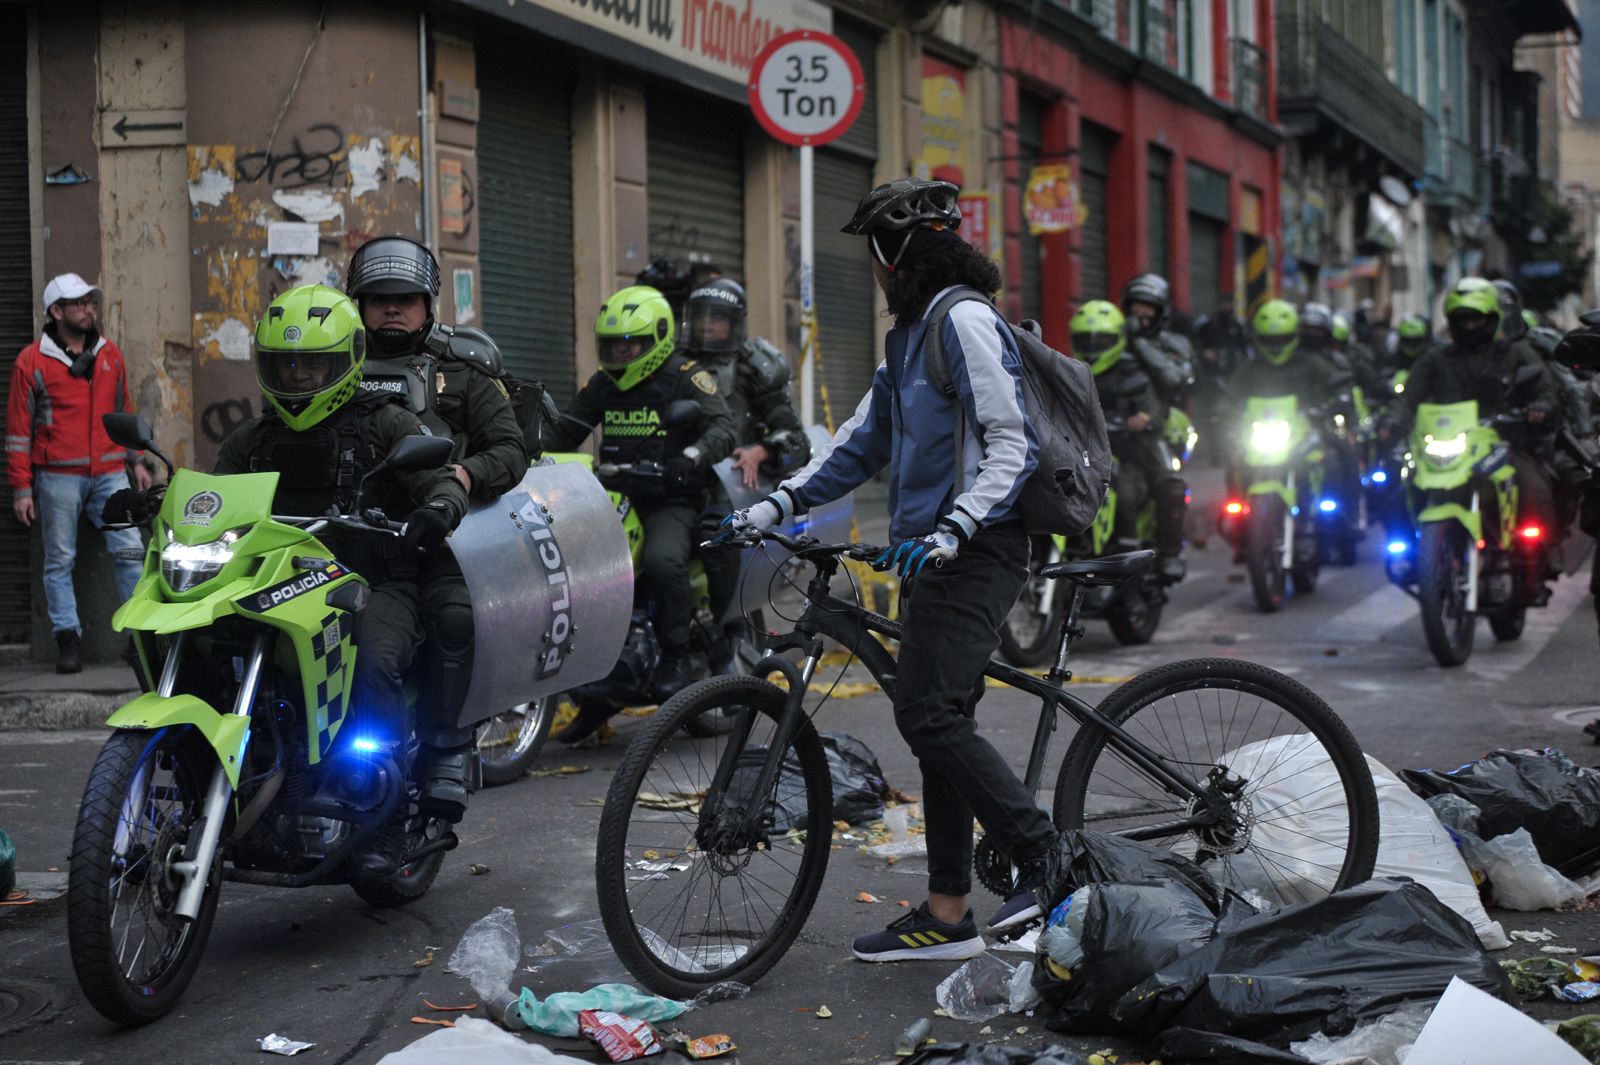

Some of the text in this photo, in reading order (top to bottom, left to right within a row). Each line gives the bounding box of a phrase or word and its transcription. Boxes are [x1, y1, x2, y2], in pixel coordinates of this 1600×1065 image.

[785, 54, 829, 84] 3.5
[776, 87, 837, 117] Ton
[604, 405, 660, 424] POLICÍA
[178, 520, 211, 528] HONDA
[270, 571, 330, 604] POLICÍA
[519, 500, 571, 673] POLICIA
